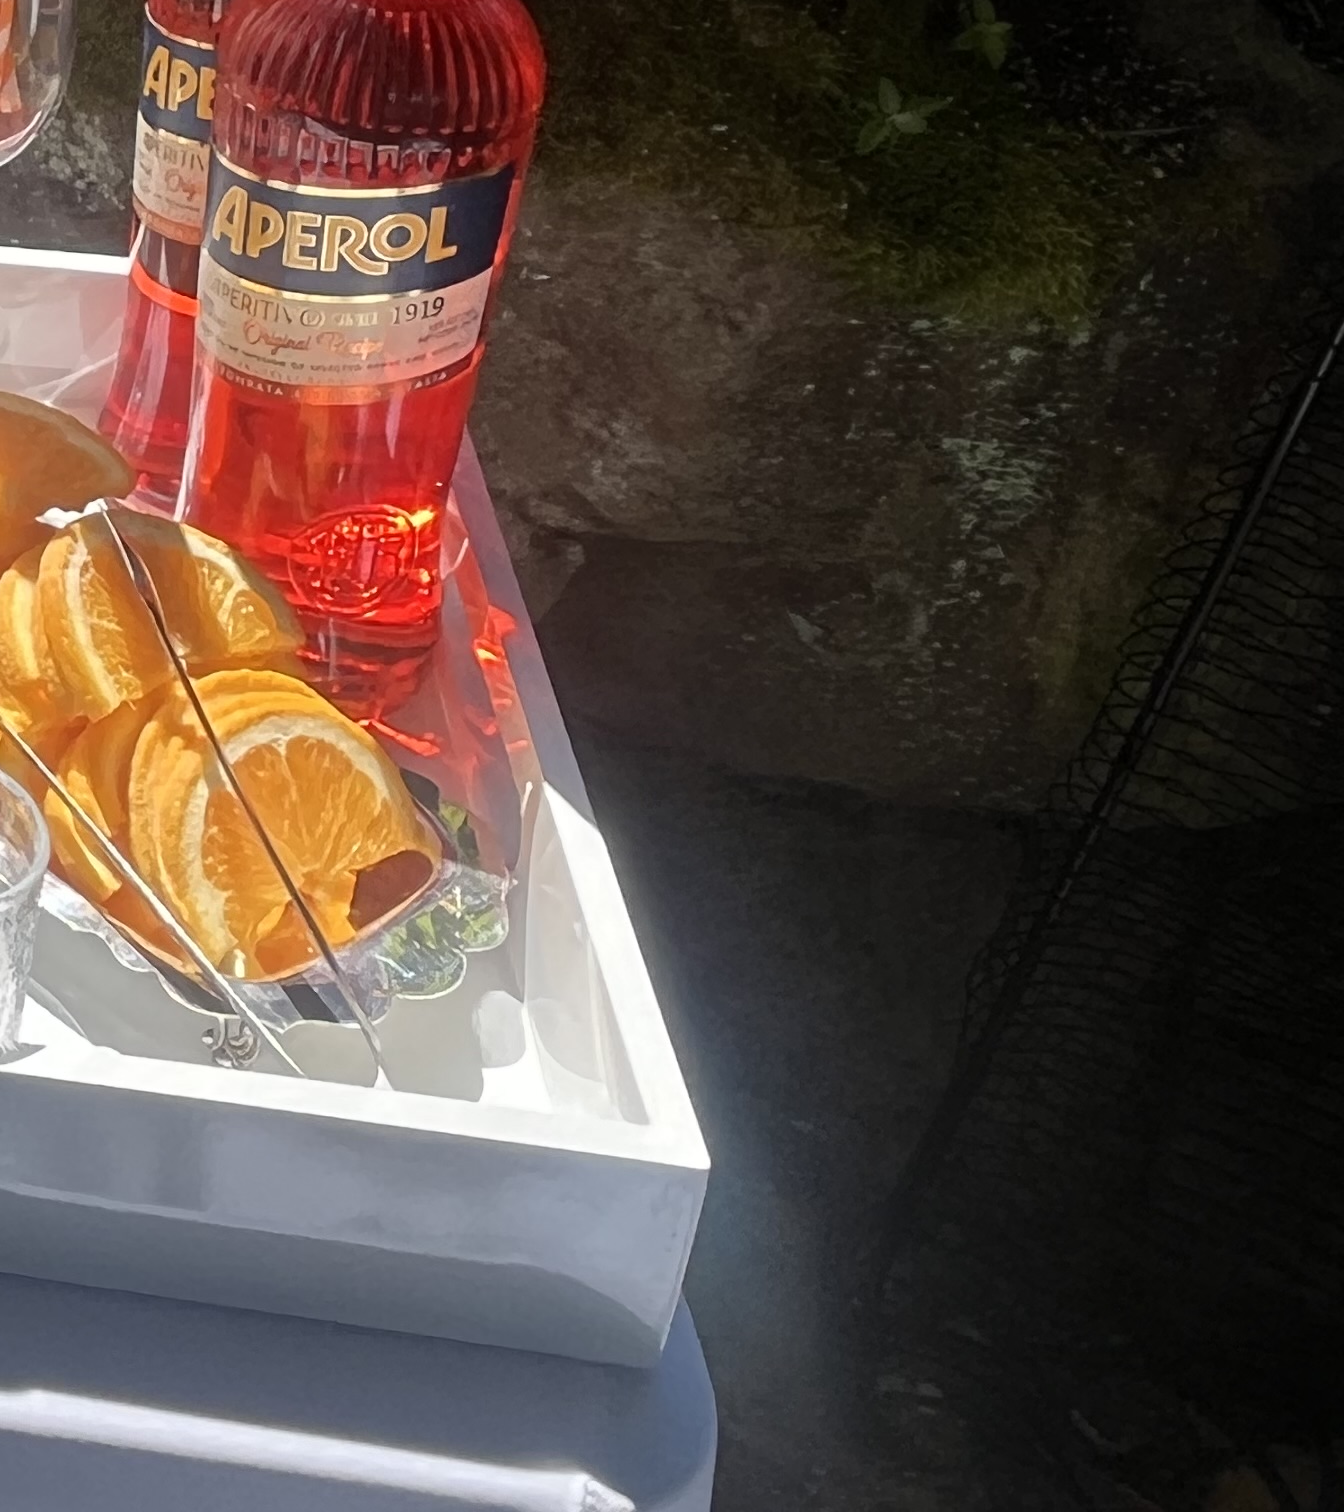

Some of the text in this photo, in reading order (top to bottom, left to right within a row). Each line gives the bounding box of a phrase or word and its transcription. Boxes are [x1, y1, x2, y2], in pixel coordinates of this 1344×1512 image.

[143, 44, 217, 122] APE
[211, 185, 459, 277] APEROL
[390, 295, 446, 326] 1919
